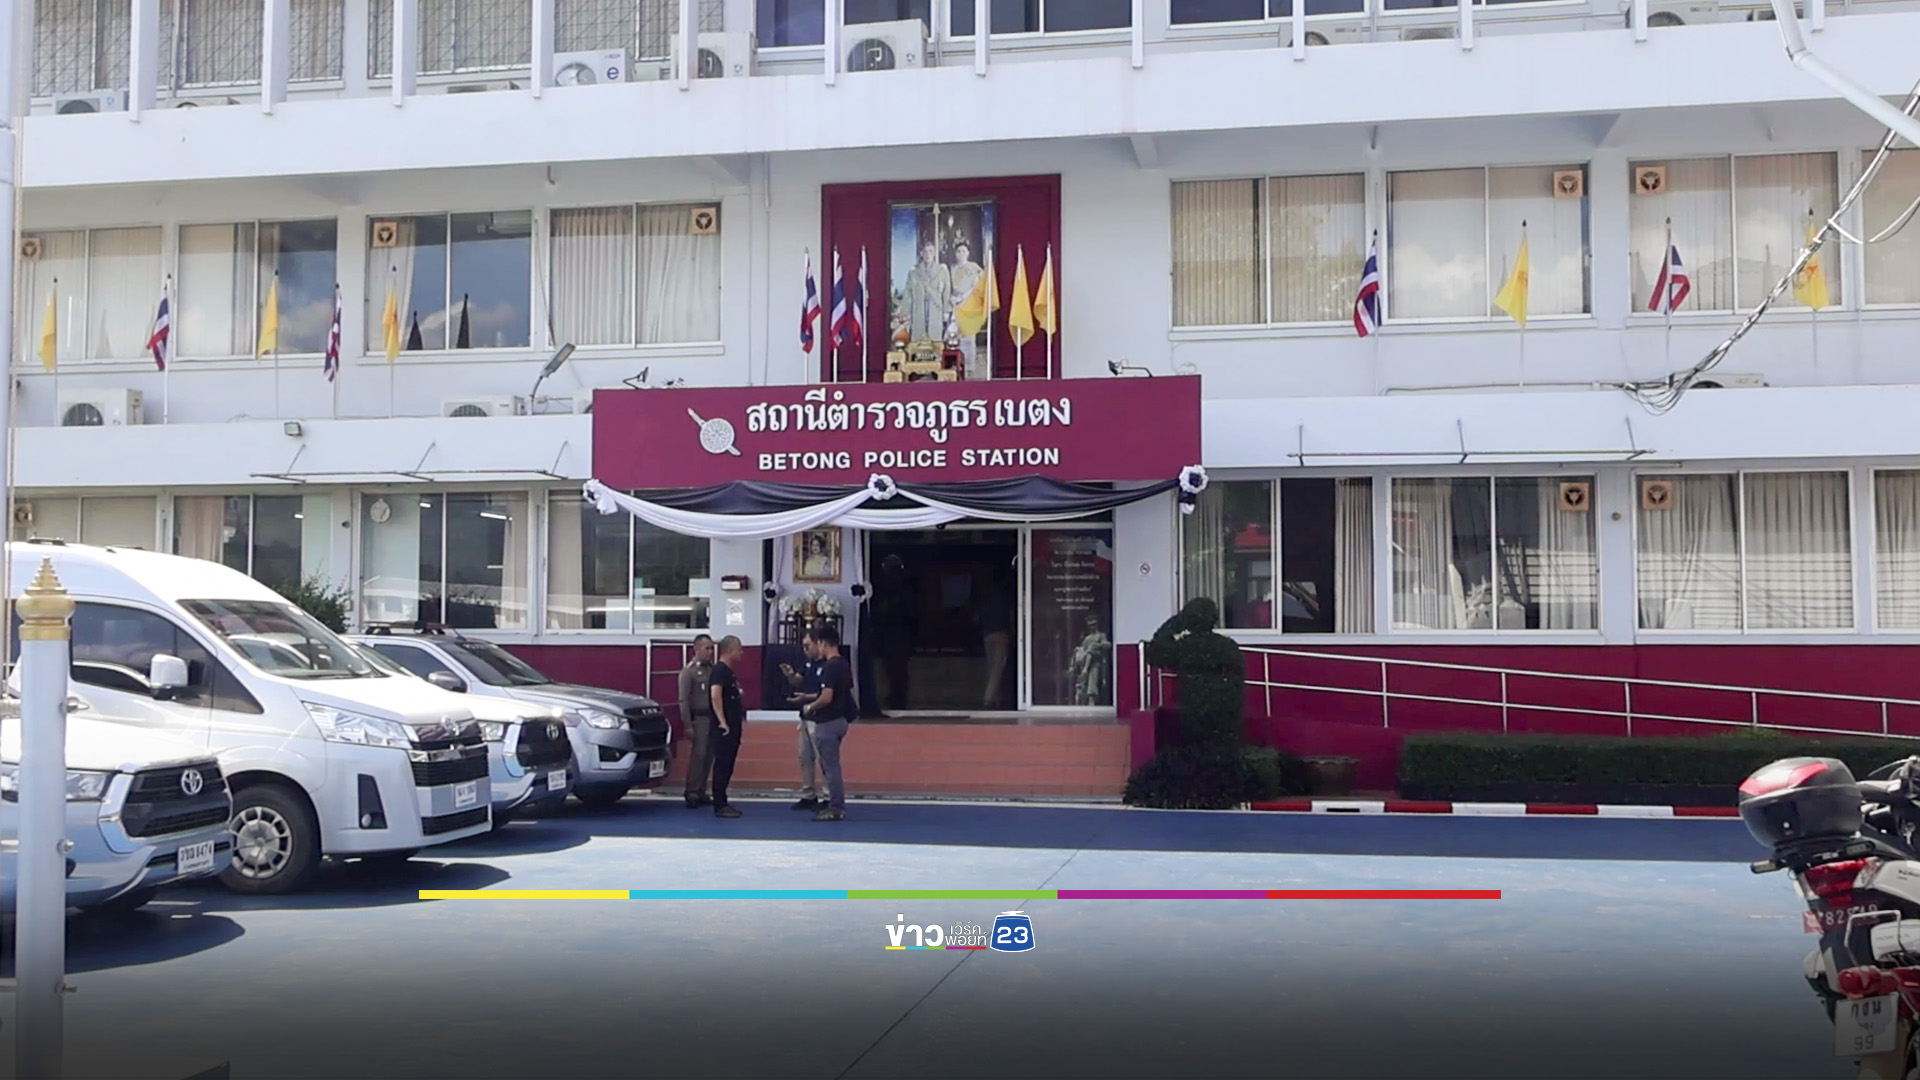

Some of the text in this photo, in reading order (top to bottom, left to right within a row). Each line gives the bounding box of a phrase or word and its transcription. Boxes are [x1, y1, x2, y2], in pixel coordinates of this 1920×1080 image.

[758, 447, 1060, 471] BETONG POLICE STATION
[1854, 1034, 1874, 1051] 99
